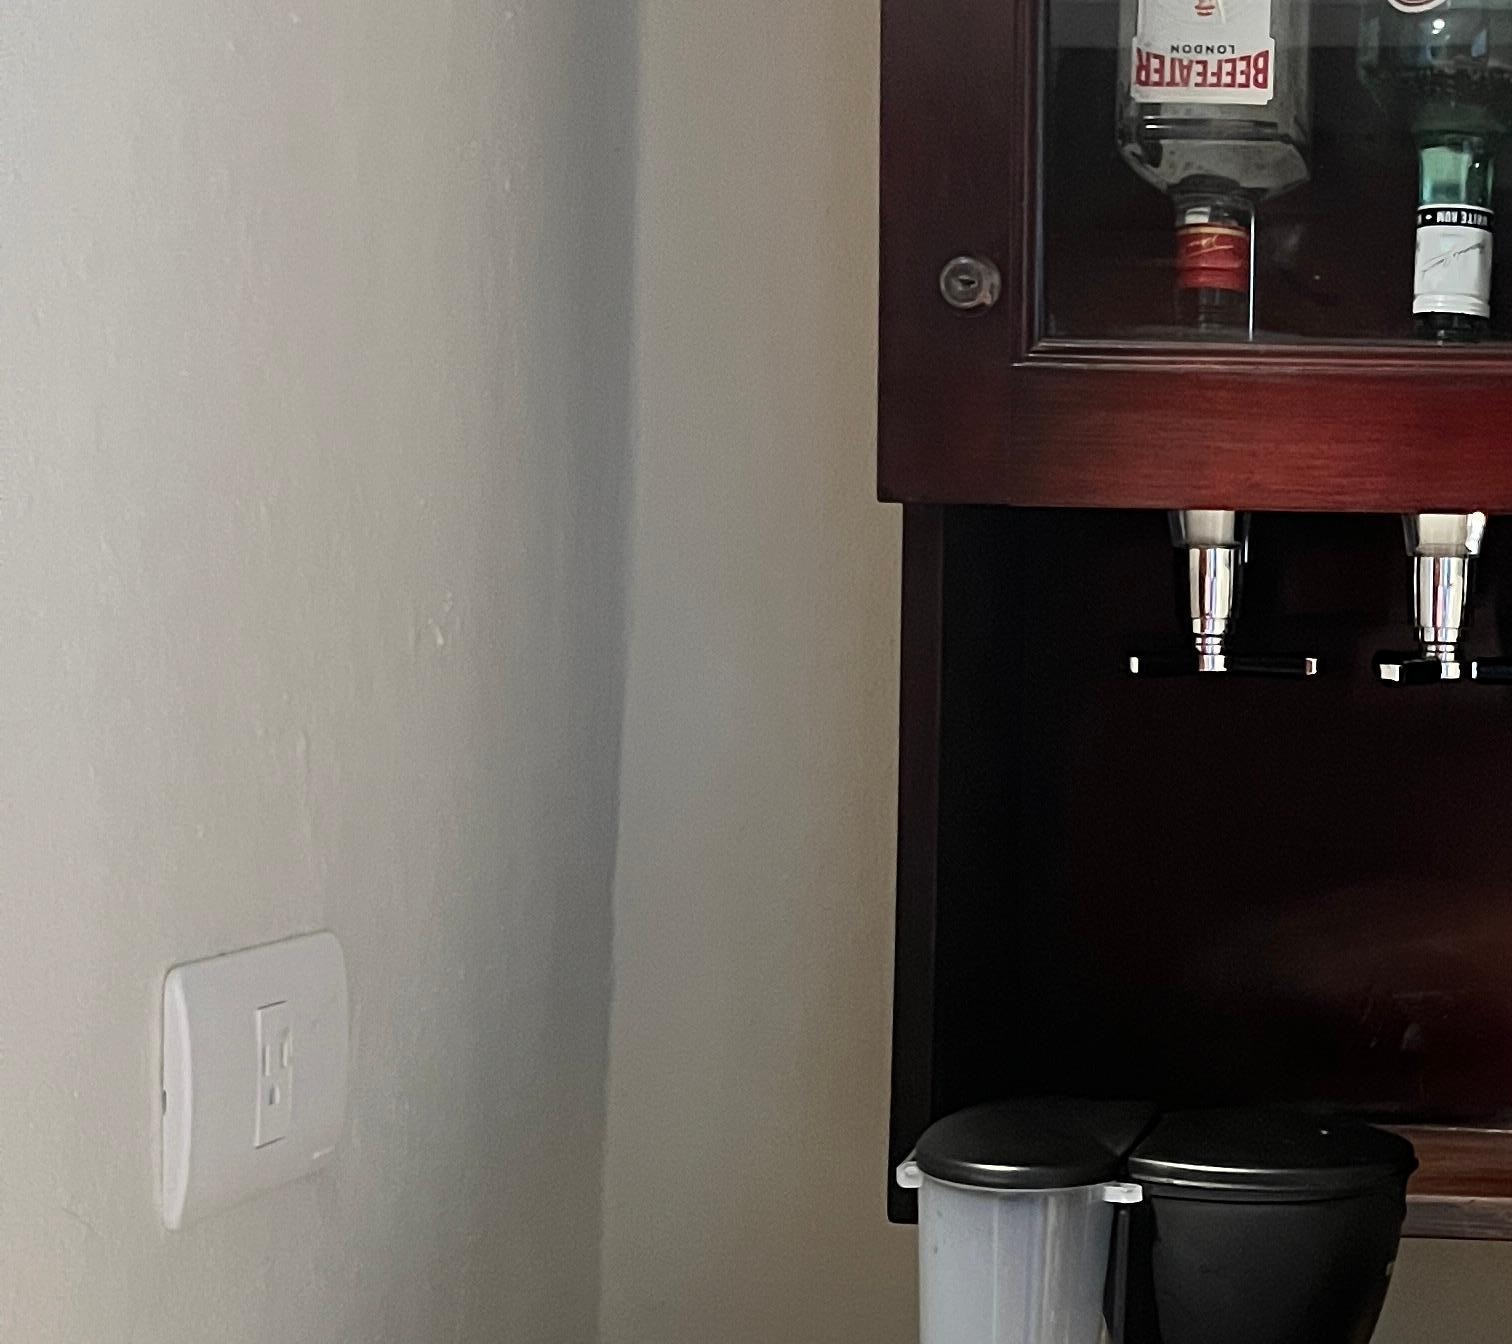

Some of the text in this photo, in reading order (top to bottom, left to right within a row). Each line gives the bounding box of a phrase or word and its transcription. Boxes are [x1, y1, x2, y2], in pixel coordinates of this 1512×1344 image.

[1169, 43, 1236, 56] LONDON
[1135, 46, 1270, 90] BEEFEATER
[1436, 211, 1458, 223] RUM
